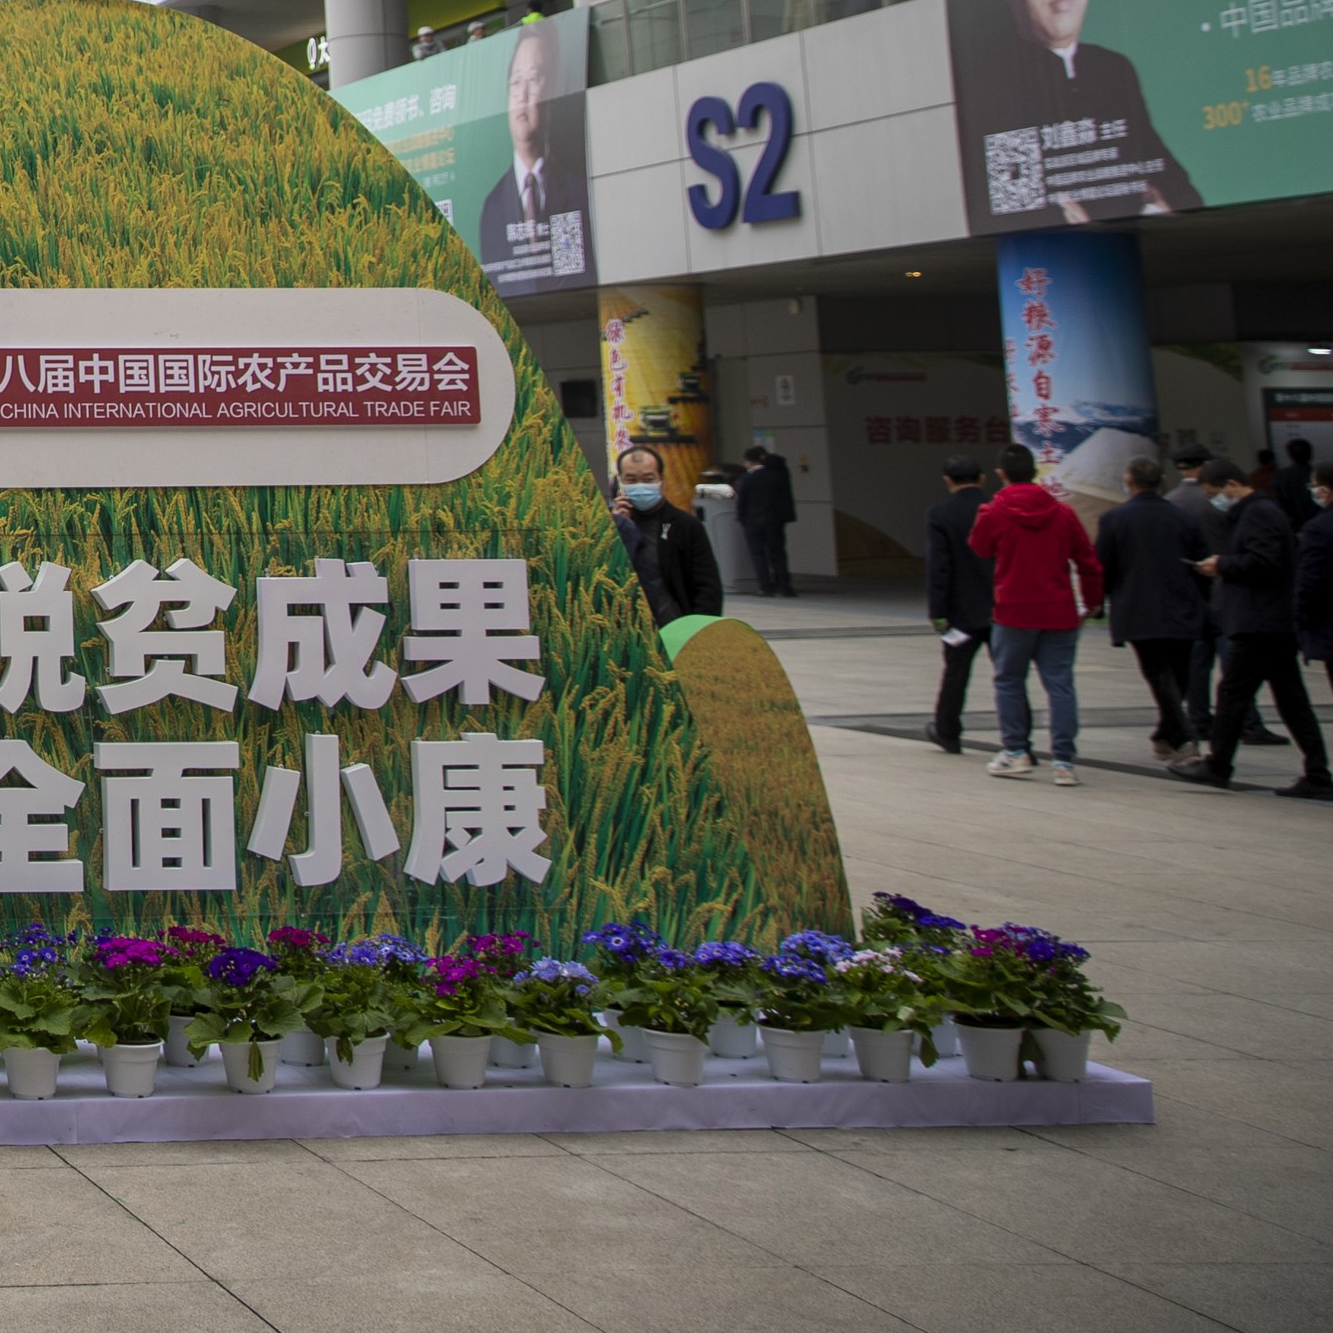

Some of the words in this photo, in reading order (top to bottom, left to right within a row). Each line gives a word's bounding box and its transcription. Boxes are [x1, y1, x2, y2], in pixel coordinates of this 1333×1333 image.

[686, 81, 801, 230] S2
[0, 402, 59, 420] CHINA
[64, 401, 212, 419] INTERNATIONAL
[217, 401, 359, 419] AGRICULTURAL
[363, 401, 425, 418] TRADE
[430, 400, 472, 418] FAIR
[1016, 266, 1071, 501] 好粮源自寒土地
[866, 416, 1010, 445] 咨询服务台
